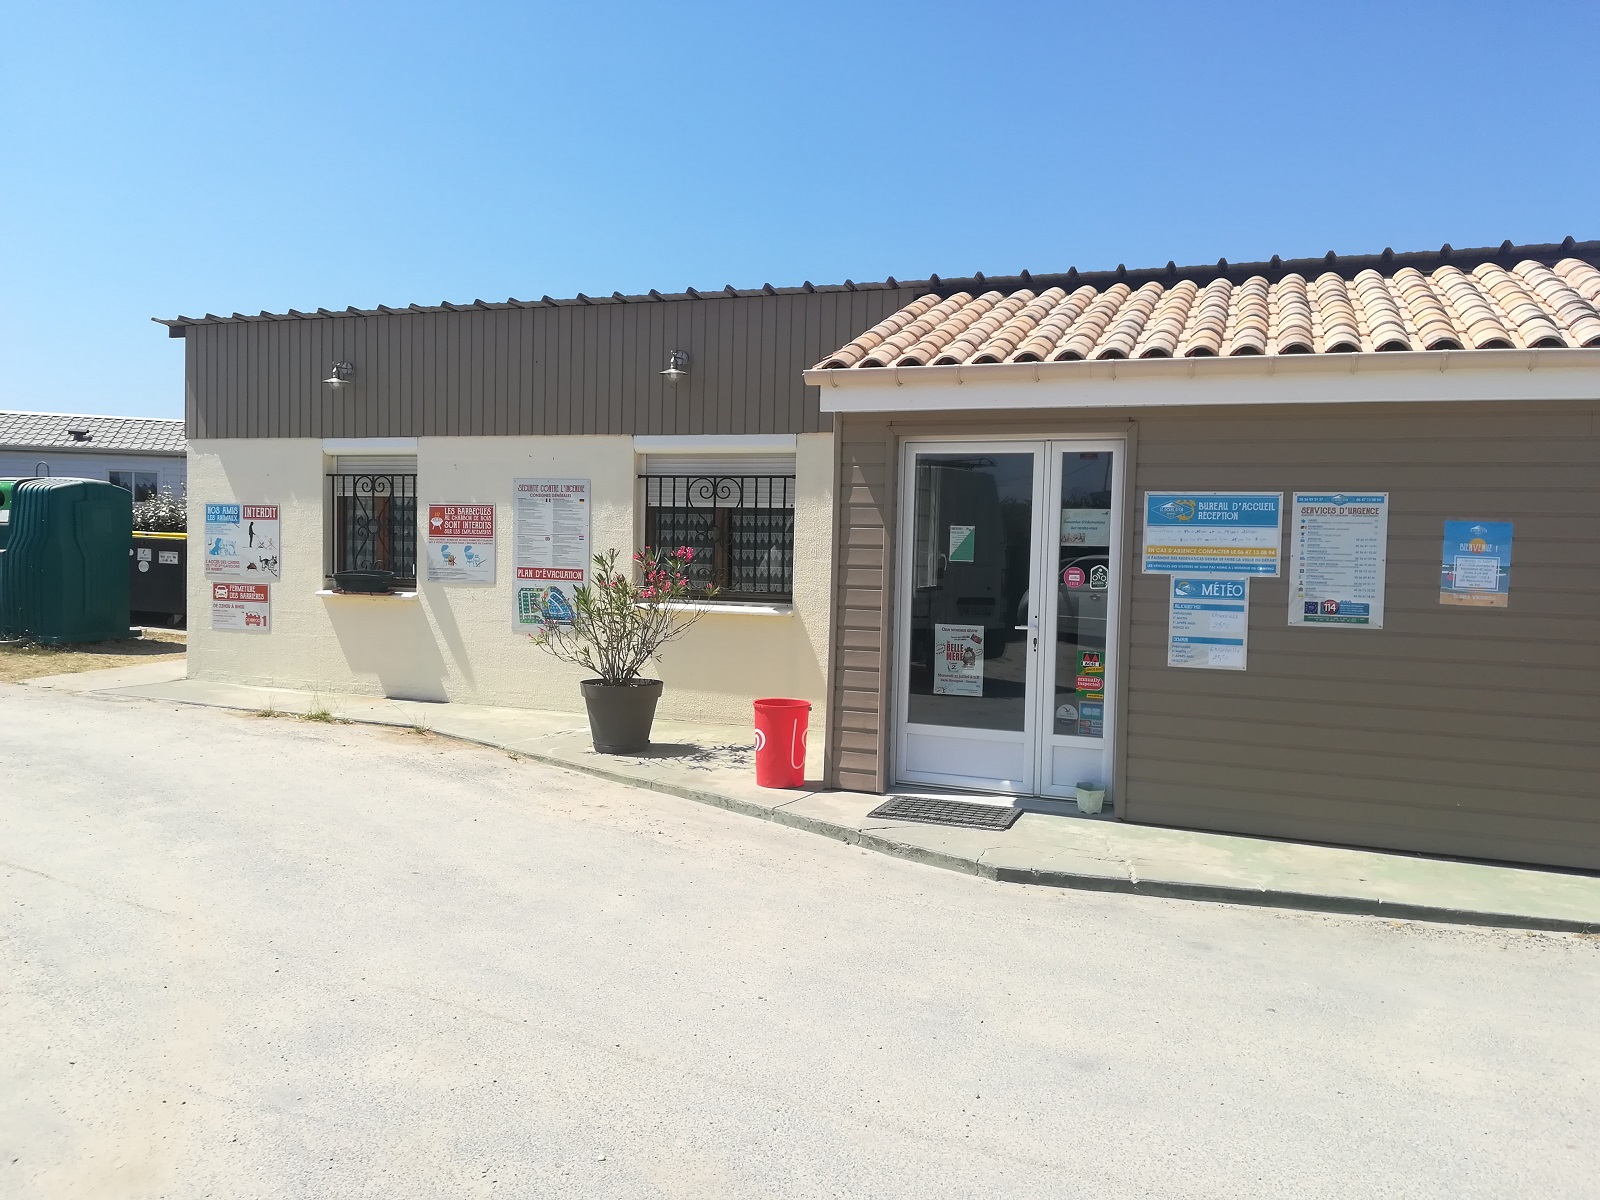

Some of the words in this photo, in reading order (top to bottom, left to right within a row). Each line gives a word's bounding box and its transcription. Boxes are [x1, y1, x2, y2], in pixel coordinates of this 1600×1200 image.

[222, 507, 238, 515] AMIS
[1198, 502, 1229, 511] BUREAU
[1232, 502, 1275, 511] D'ACCUEIL
[1301, 506, 1336, 514] SERVICES
[1340, 507, 1380, 515] D'URGENCE
[244, 507, 276, 518] INTERDIT
[1198, 510, 1239, 520] RÉCEPTION
[444, 521, 460, 529] SONT
[462, 521, 491, 529] INTERDITS
[517, 569, 533, 577] PLAN
[535, 569, 582, 579] D'ÉVACUATION
[1201, 582, 1243, 596] MÉTÉO
[1324, 603, 1336, 612] 114
[946, 643, 964, 652] BELLE
